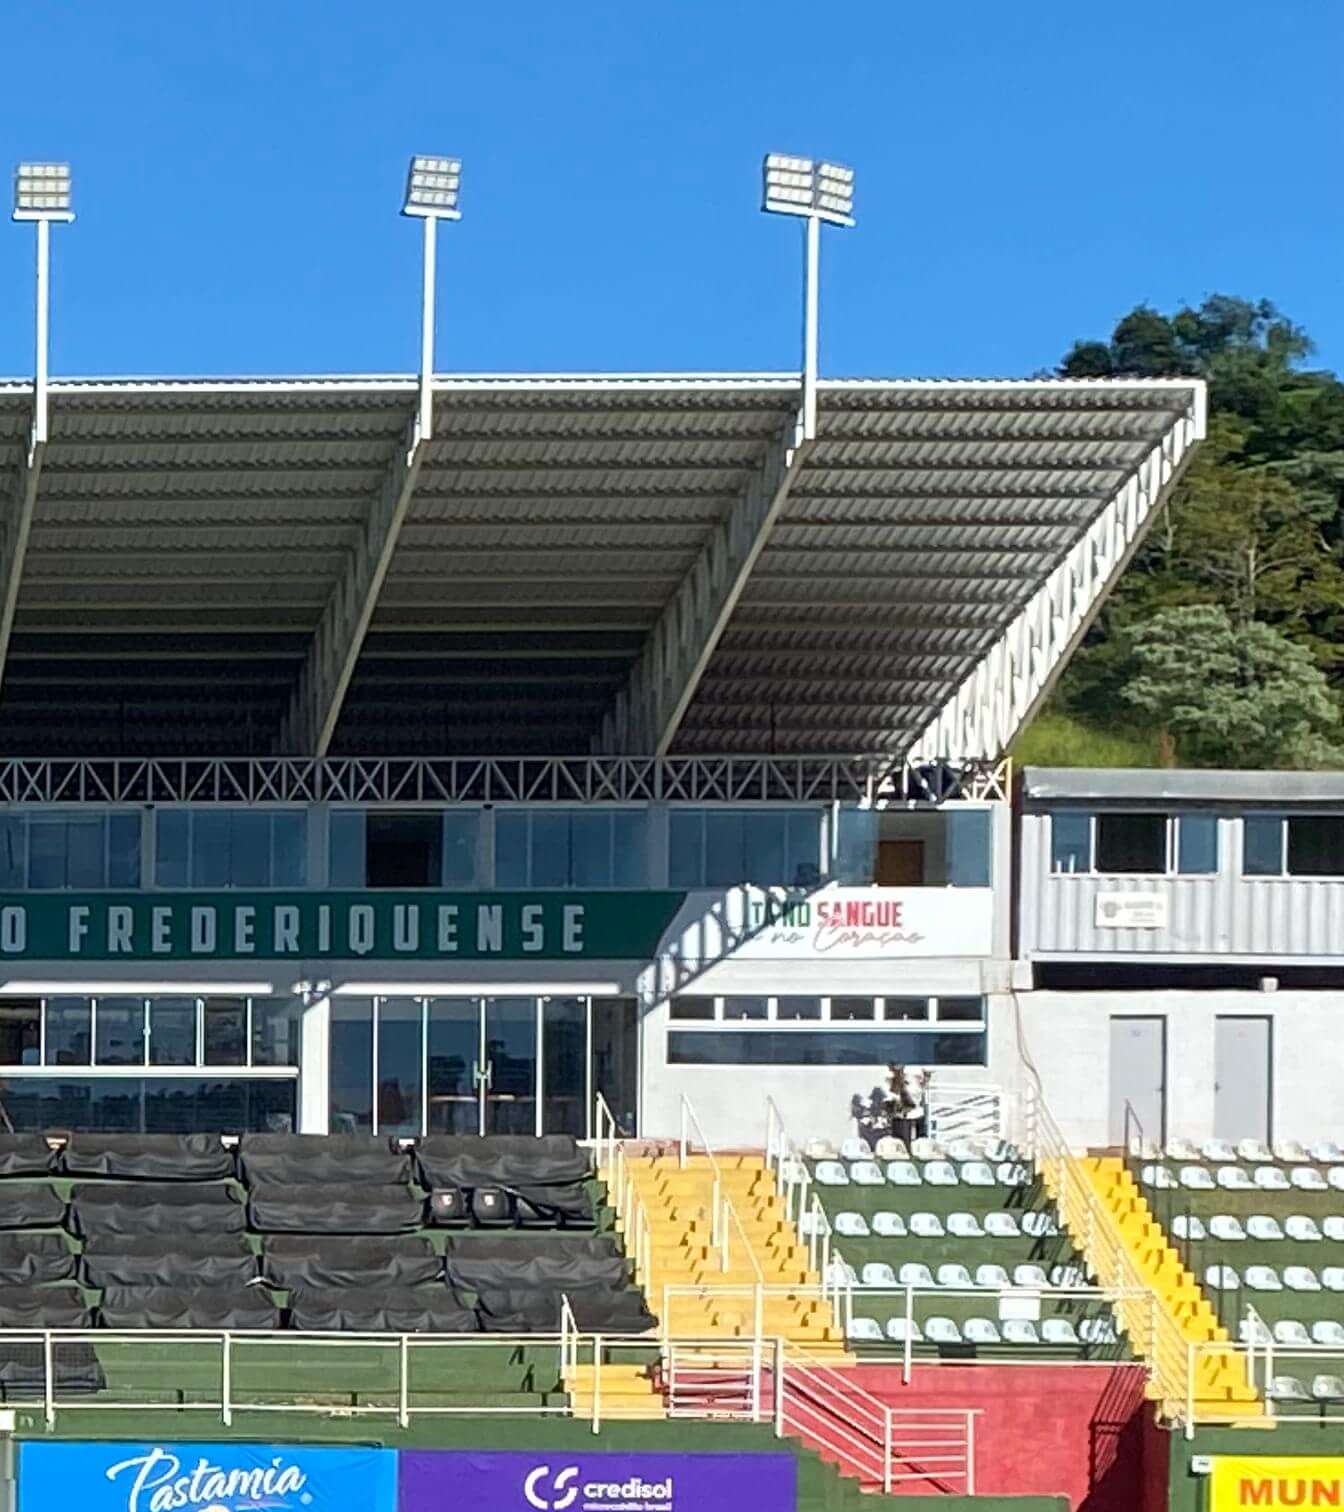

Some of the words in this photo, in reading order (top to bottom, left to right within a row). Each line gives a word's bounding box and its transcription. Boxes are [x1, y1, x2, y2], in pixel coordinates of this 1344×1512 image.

[817, 901, 903, 926] SANGUE
[70, 904, 584, 955] FREDERIQUENSE
[583, 1478, 672, 1498] credisol
[1240, 1478, 1341, 1506] MUN
